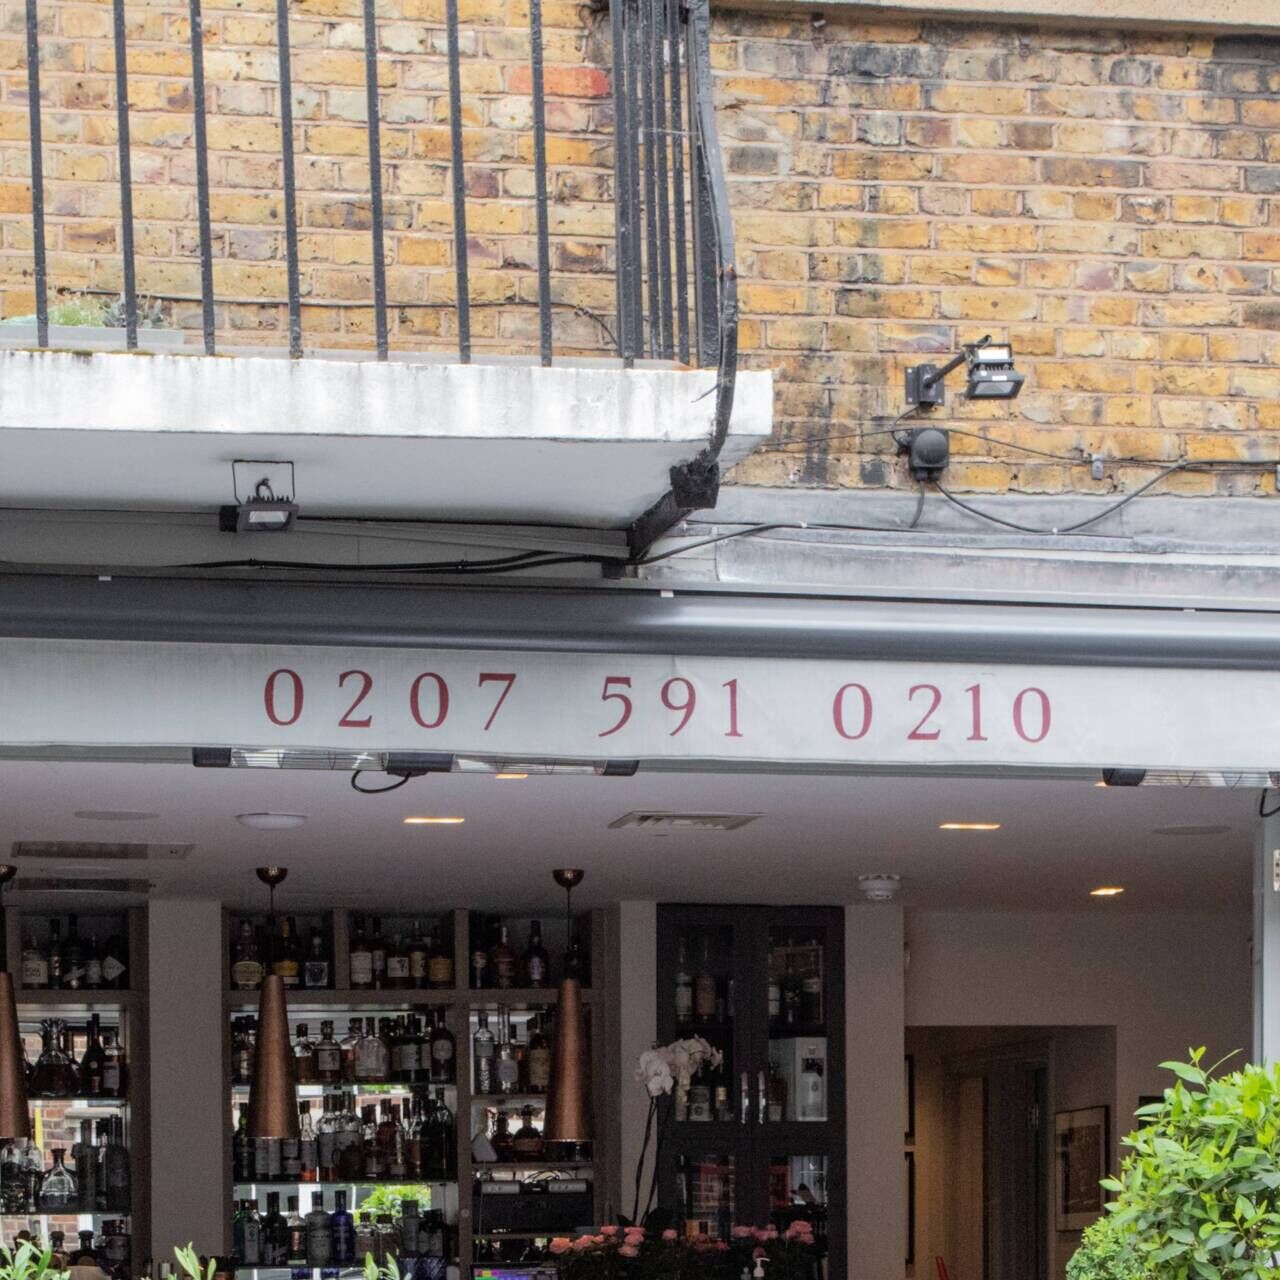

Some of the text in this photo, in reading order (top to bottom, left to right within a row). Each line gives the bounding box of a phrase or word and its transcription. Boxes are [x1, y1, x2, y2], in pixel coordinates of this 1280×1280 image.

[264, 668, 1053, 743] 0207 591 0210
